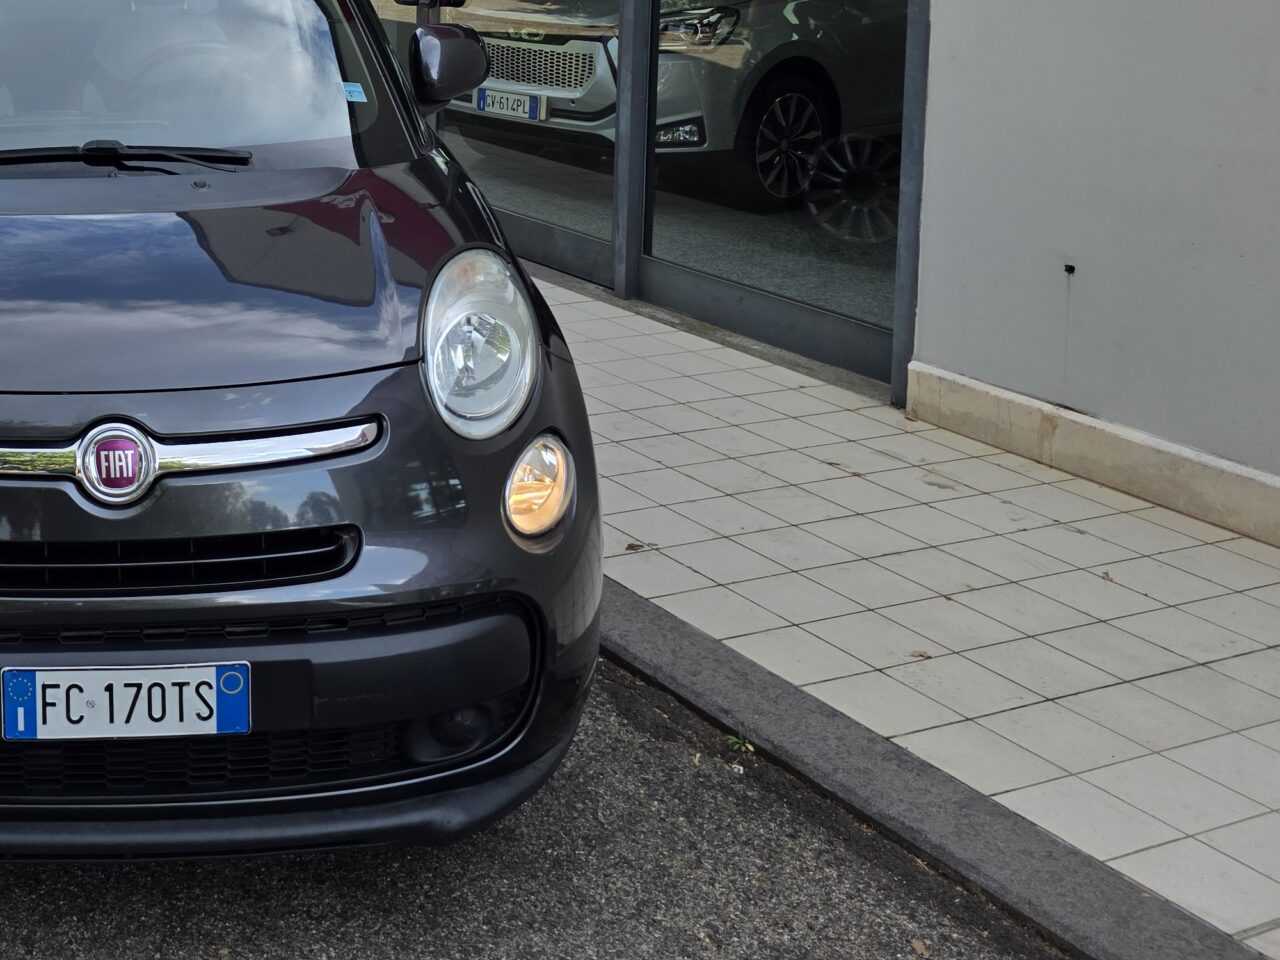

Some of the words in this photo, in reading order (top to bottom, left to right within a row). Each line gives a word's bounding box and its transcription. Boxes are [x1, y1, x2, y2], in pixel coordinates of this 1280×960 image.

[100, 450, 135, 479] FIAT
[41, 681, 85, 725] FC
[104, 680, 214, 724] 170TS
